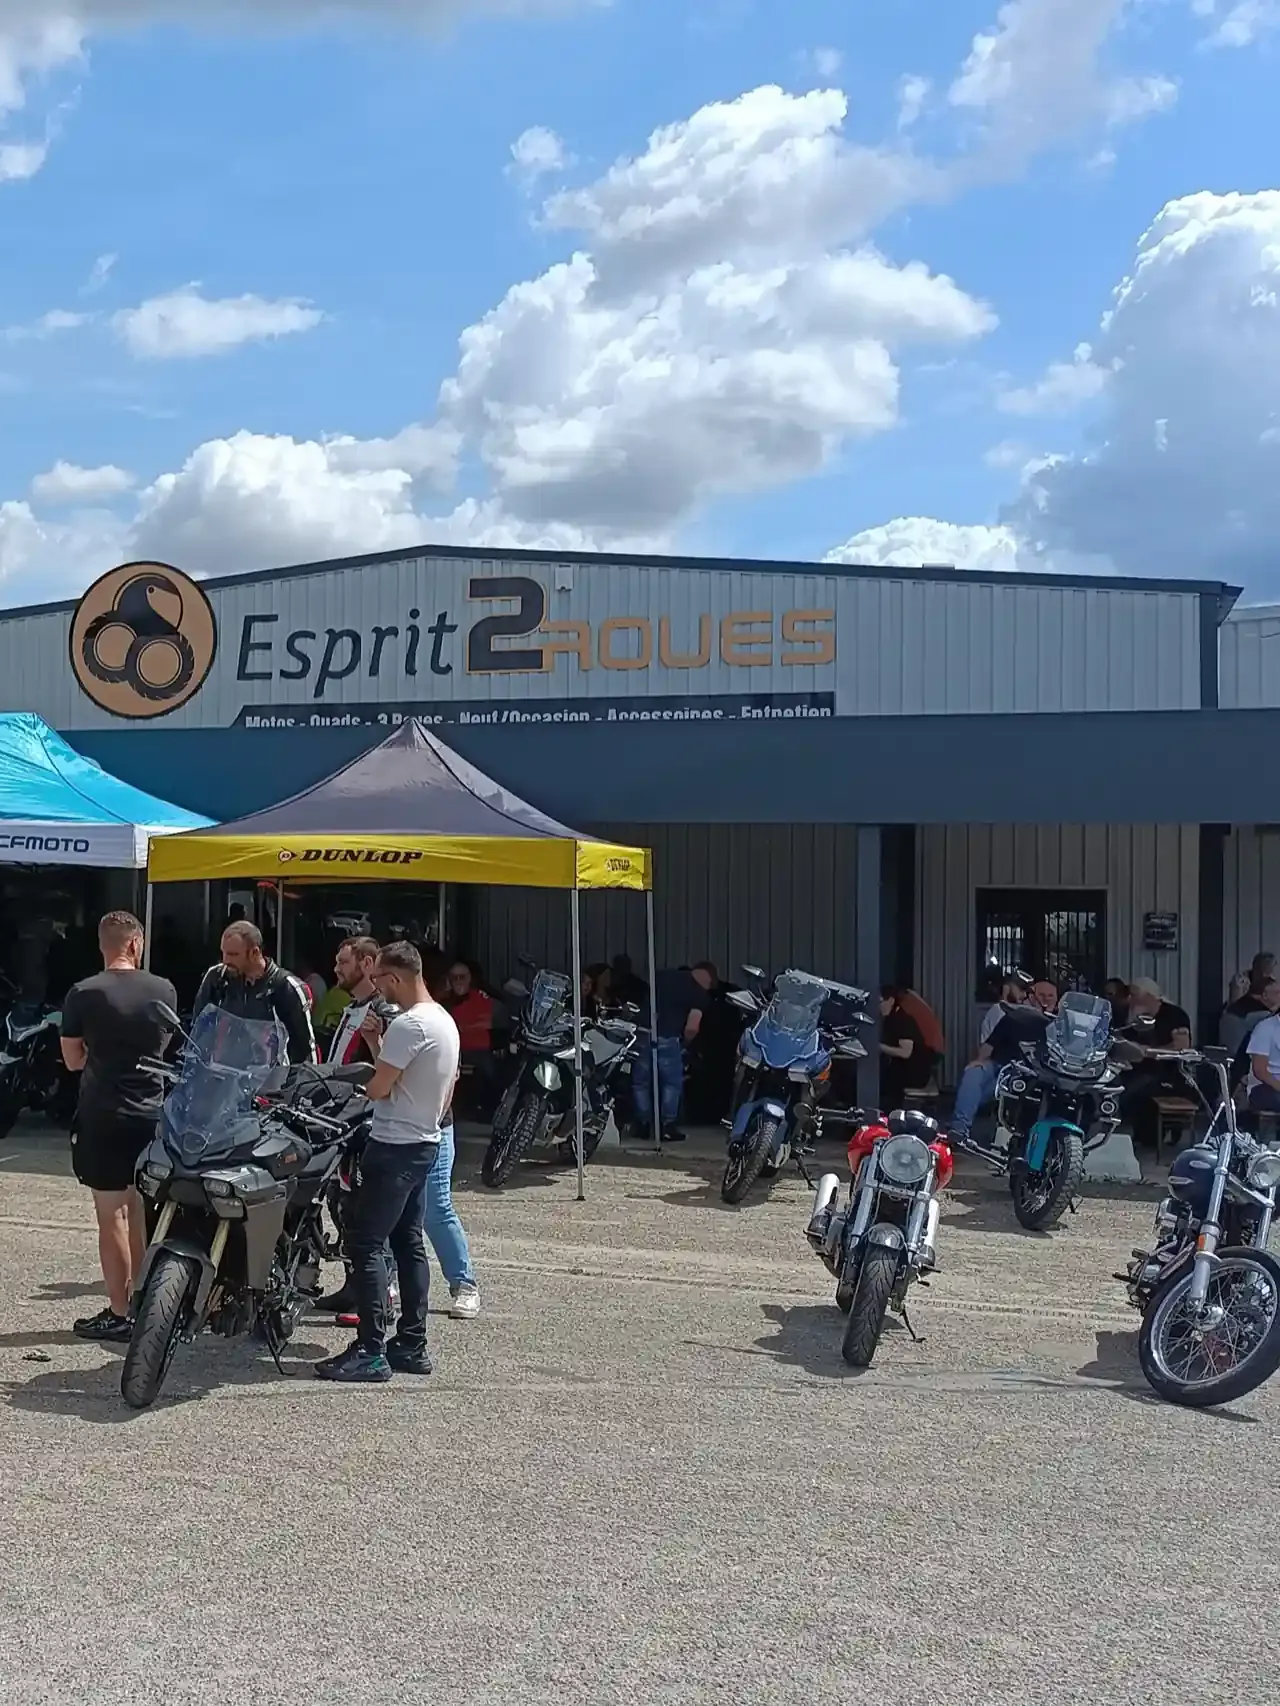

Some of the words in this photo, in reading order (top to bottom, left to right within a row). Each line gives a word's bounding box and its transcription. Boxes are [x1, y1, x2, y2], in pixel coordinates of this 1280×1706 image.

[236, 608, 459, 699] Esprit
[467, 576, 548, 674] 2
[539, 610, 835, 671] ROUES
[392, 711, 443, 725] Res
[299, 848, 424, 865] DUNLOP
